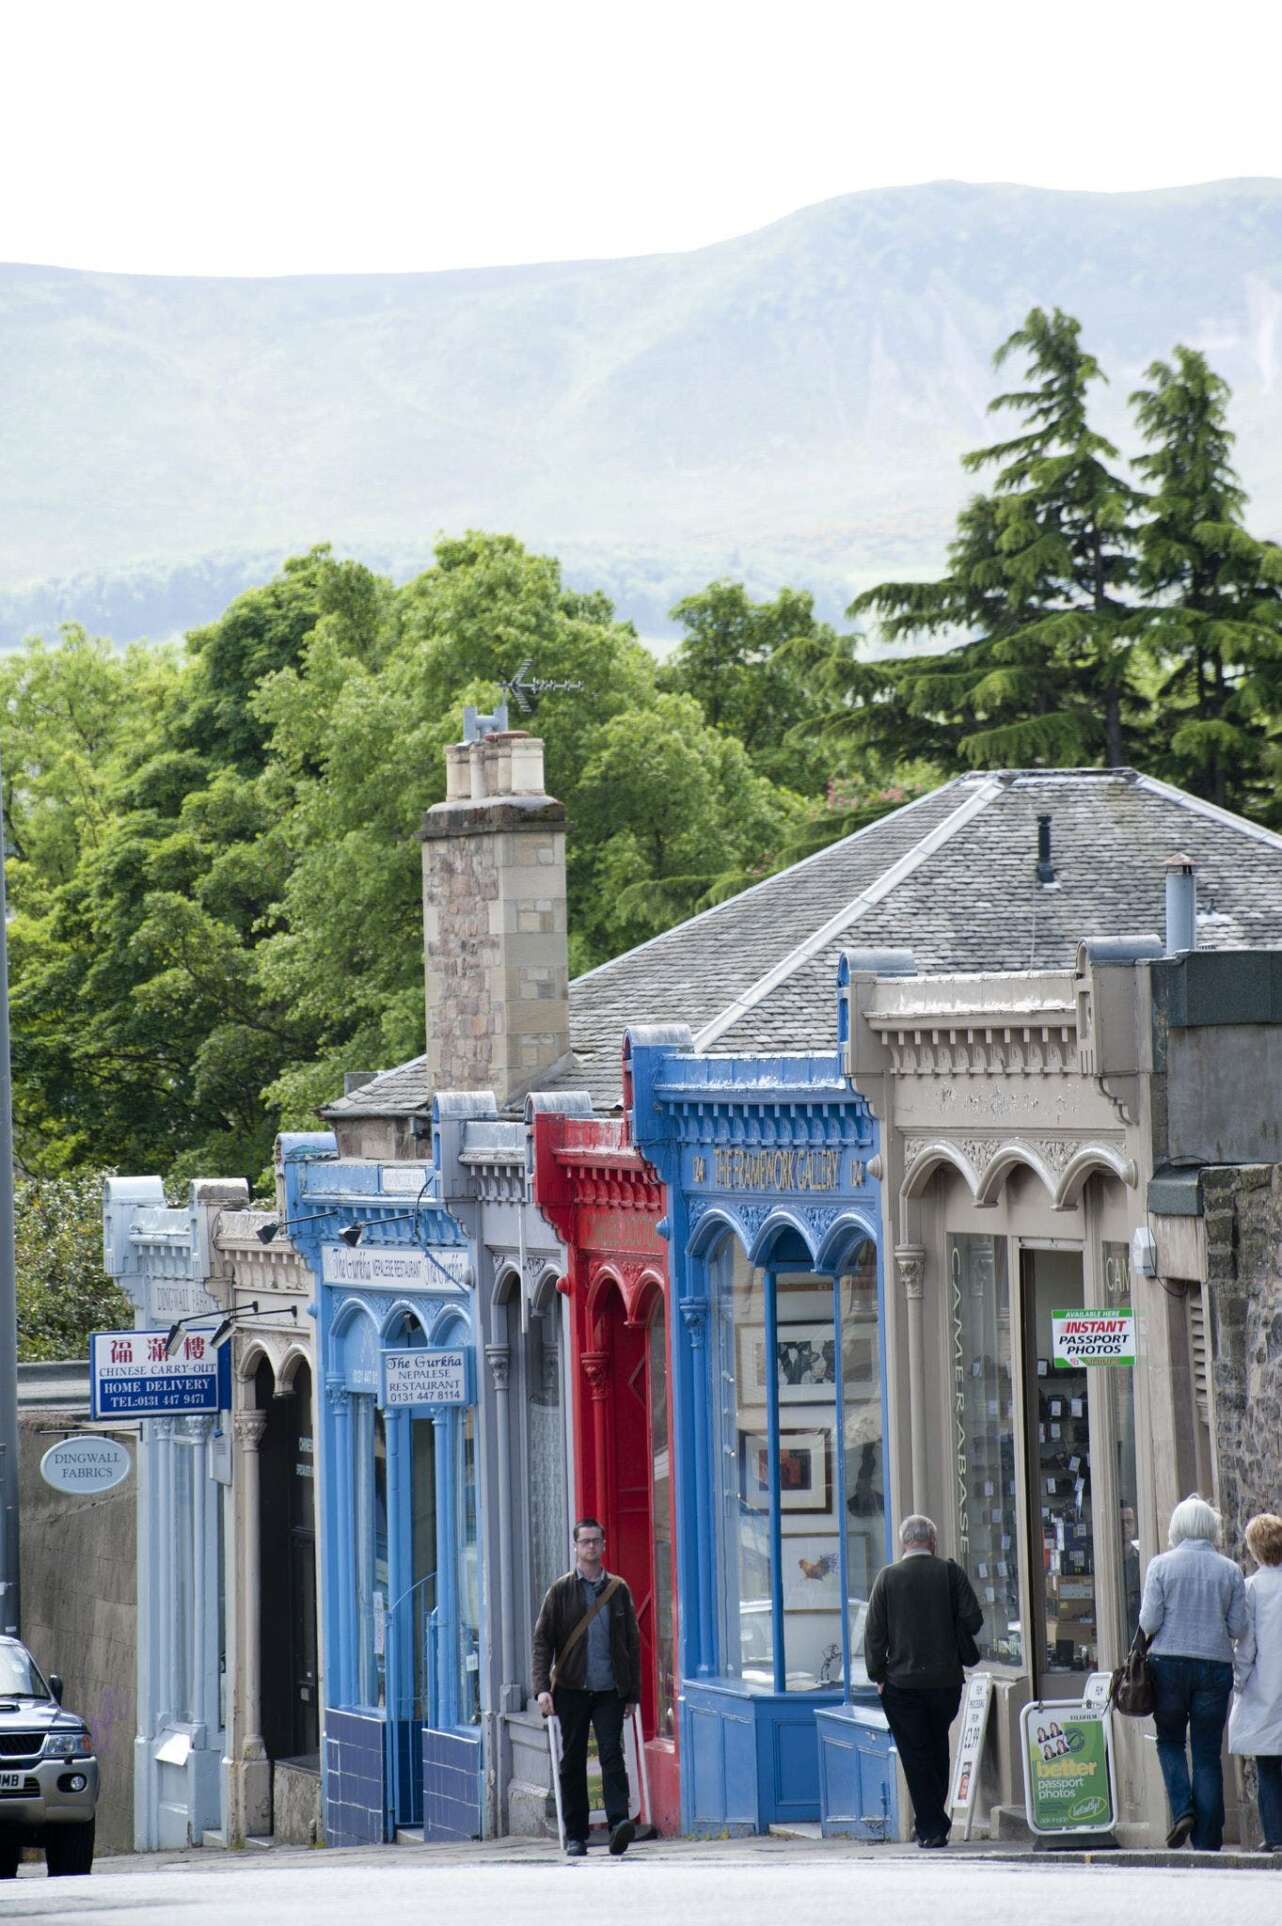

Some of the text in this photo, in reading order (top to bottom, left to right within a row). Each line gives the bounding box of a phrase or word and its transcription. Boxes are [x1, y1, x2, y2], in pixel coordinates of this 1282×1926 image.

[736, 1150, 798, 1190] FRAMEWORK
[799, 1151, 839, 1191] GALLERY
[1066, 1321, 1126, 1334] INSTANT
[1059, 1334, 1130, 1345] PASSPORT
[1067, 1345, 1122, 1355] PHOTOS
[385, 1355, 462, 1370] The Gurkha
[99, 1363, 216, 1378] CHINESE CARRY-OUT
[398, 1370, 451, 1380] NEPALESE
[104, 1378, 210, 1394] HOME DELIVERY
[389, 1380, 461, 1392] RESTAURANT
[110, 1393, 205, 1408] TEL:0131 447 9471
[390, 1390, 460, 1402] 0131 447 8114
[54, 1452, 121, 1465] DINGWALL
[62, 1467, 113, 1479] FABRICS
[1036, 1759, 1097, 1779] better
[1037, 1777, 1084, 1791] passport
[1038, 1788, 1076, 1801] photos
